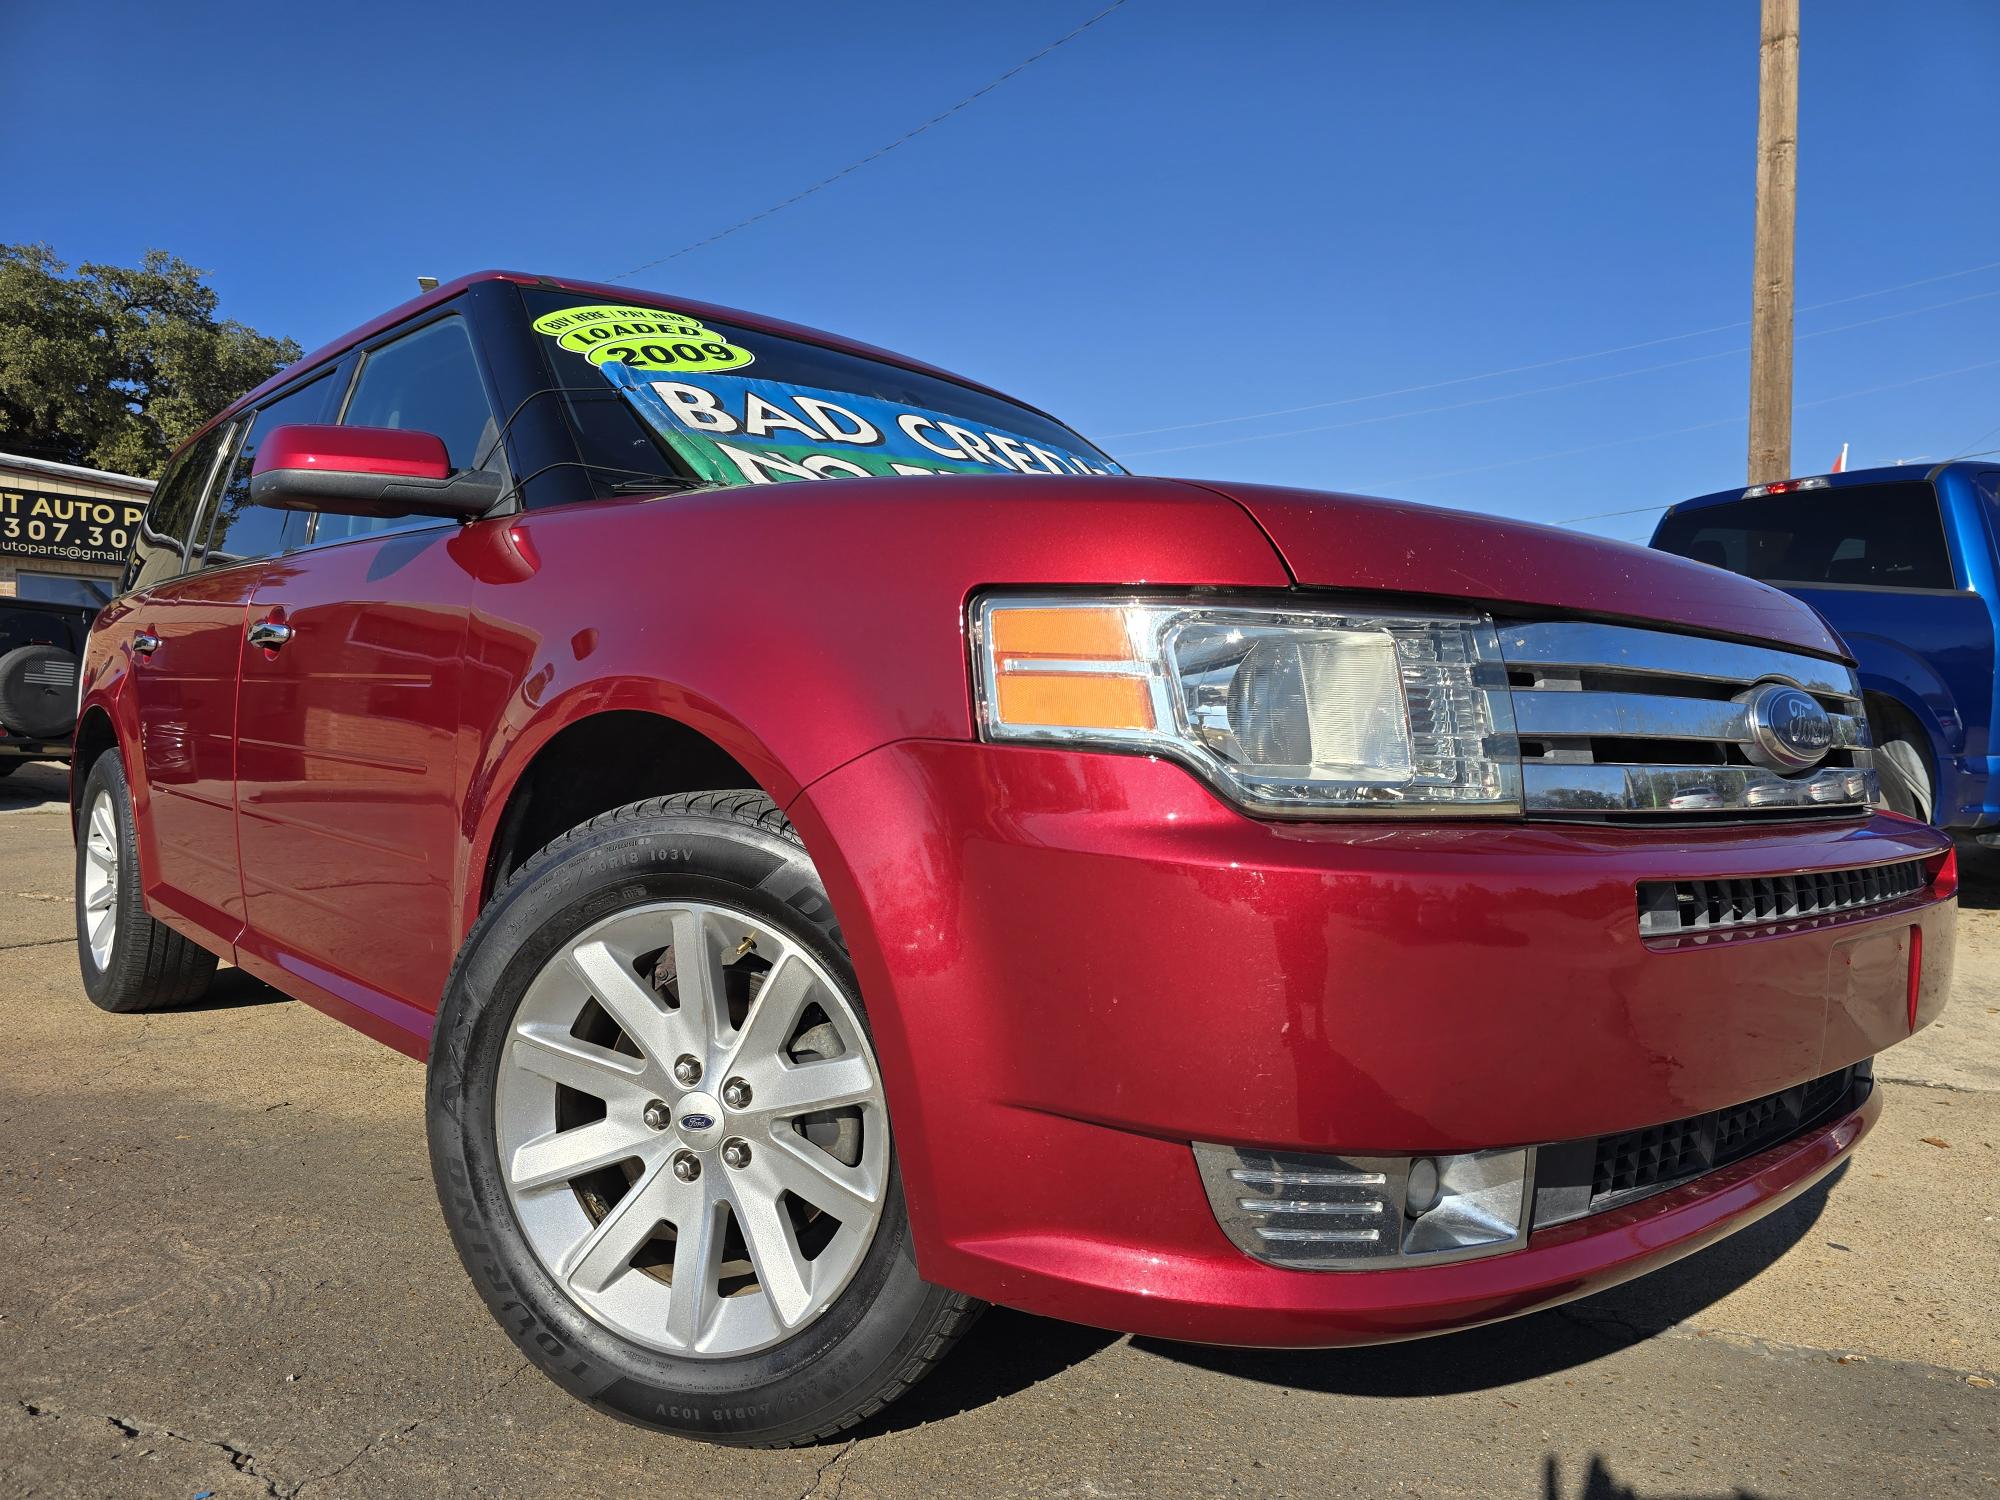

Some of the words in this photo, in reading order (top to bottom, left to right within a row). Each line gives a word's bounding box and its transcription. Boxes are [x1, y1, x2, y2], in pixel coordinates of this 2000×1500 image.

[544, 317, 573, 330] BUY
[571, 310, 606, 322] HERE
[620, 310, 646, 318] PAY
[650, 312, 688, 323] HERE
[572, 323, 701, 345] LOADED
[606, 343, 735, 367] 2009
[650, 381, 879, 444] BAD
[30, 497, 115, 525] AUTO
